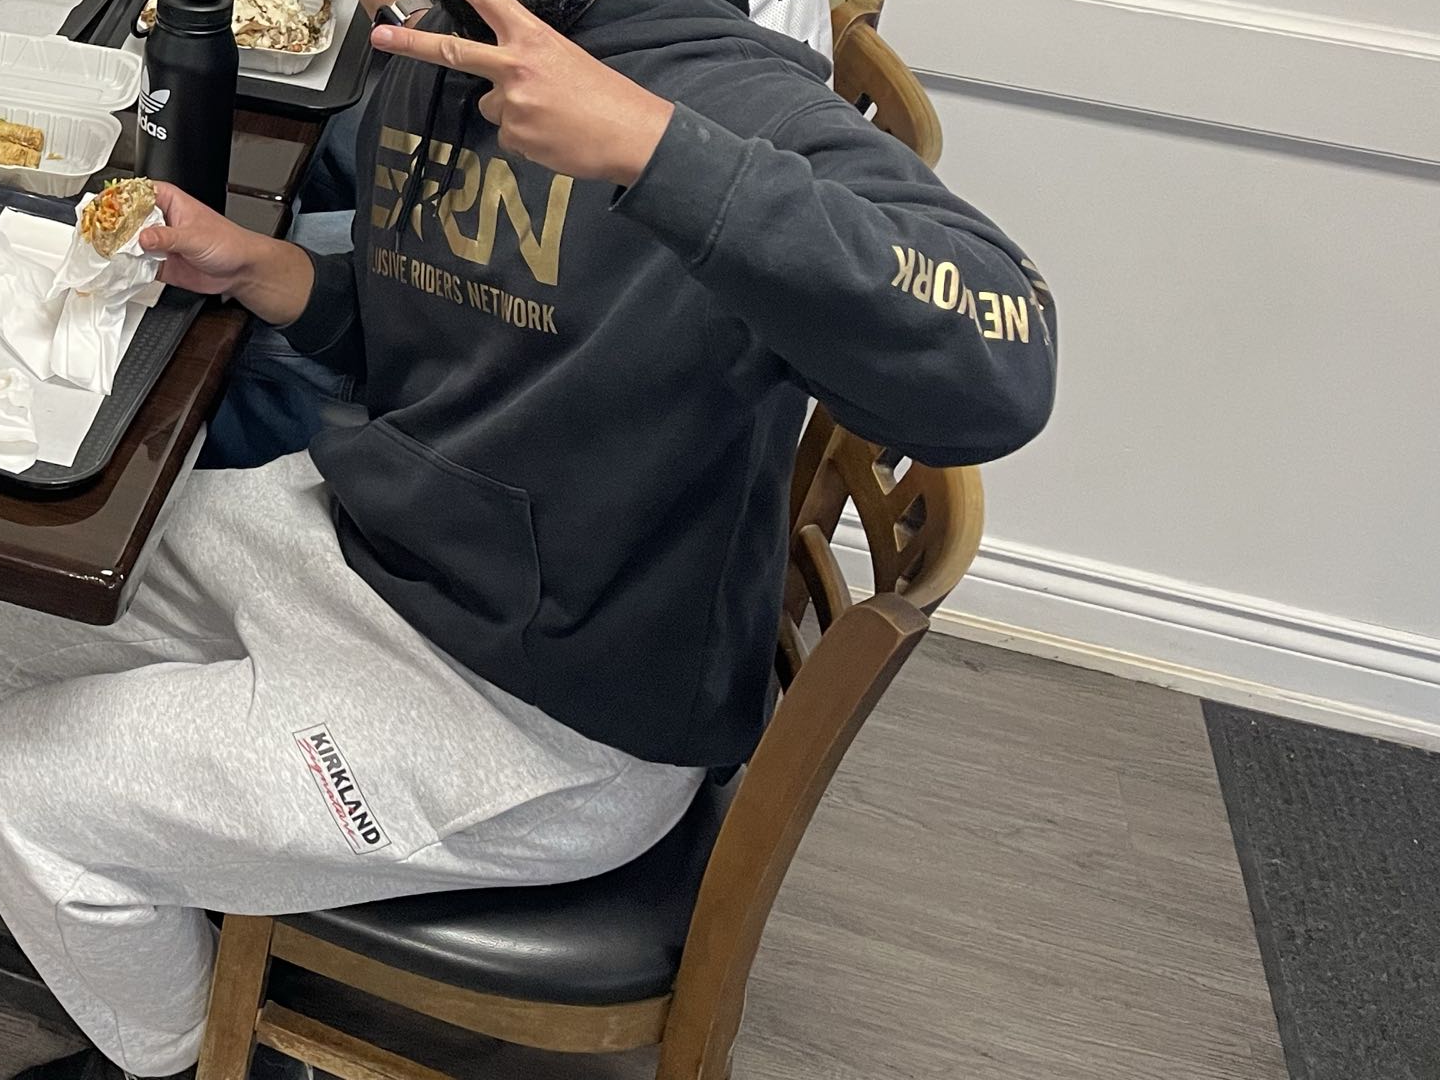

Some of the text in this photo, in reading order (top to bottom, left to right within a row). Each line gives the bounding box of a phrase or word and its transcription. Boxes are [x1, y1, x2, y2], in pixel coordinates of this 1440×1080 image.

[410, 259, 464, 305] RIDERS
[466, 280, 559, 335] NETWORK
[296, 737, 362, 851] Signature
[310, 732, 381, 845] KIRKLAND
